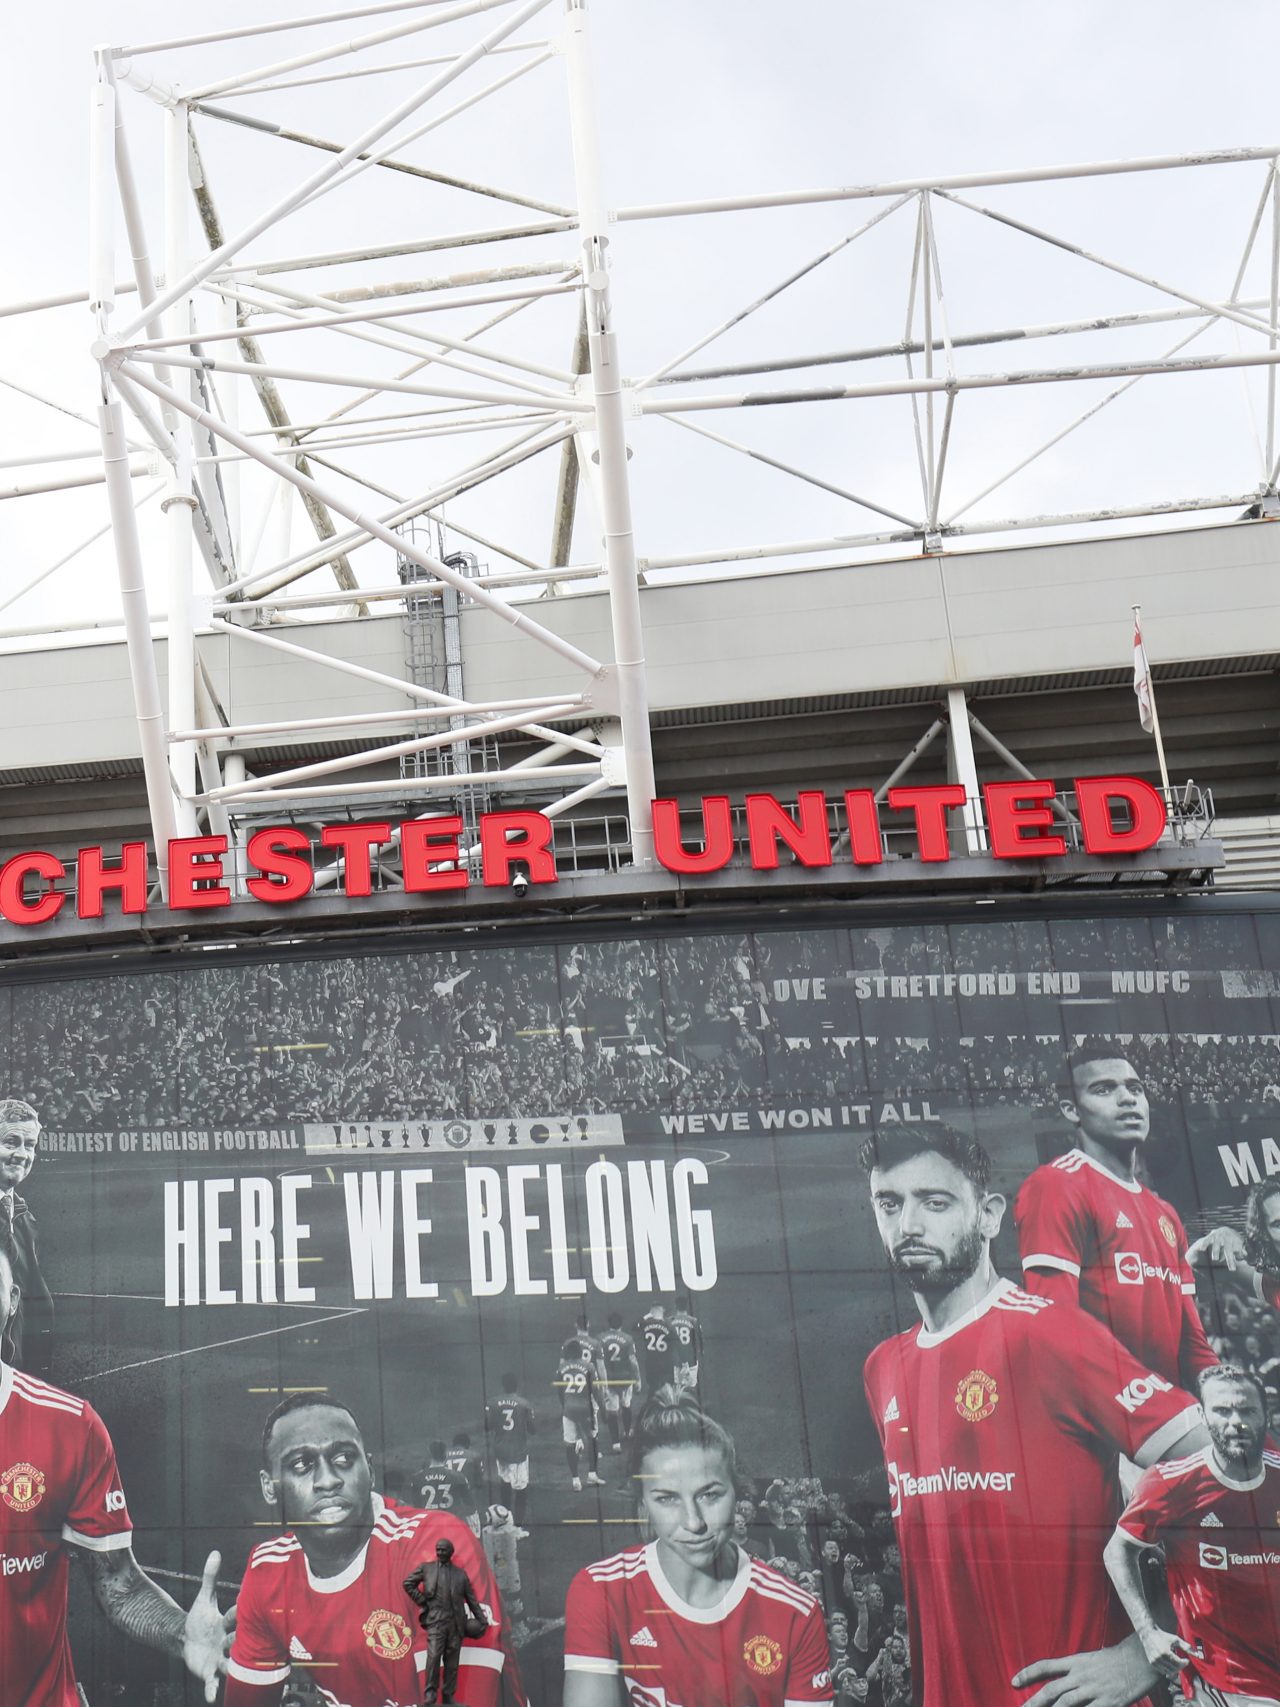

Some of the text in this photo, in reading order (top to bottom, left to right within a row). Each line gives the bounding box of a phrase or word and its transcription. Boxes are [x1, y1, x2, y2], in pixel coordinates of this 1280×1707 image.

[651, 777, 1166, 874] UNITED
[773, 970, 1191, 1002] OVE STRETFORD END MUFC
[660, 1101, 940, 1134] WE'VE WON IT ALL
[39, 1129, 300, 1152] GREATEST OF ENGLISH FOOTBALL
[164, 1157, 719, 1307] HERE WE BELONG
[644, 1332, 668, 1352] 26
[563, 1373, 587, 1394] 29
[502, 1409, 515, 1431] 3
[4, 1466, 43, 1482] MANCHESTER
[445, 1458, 467, 1472] 17
[899, 1466, 1016, 1498] TeamViewer
[9, 1499, 37, 1509] UNITED
[421, 1483, 454, 1510] 23
[382, 1643, 409, 1657] UNITED
